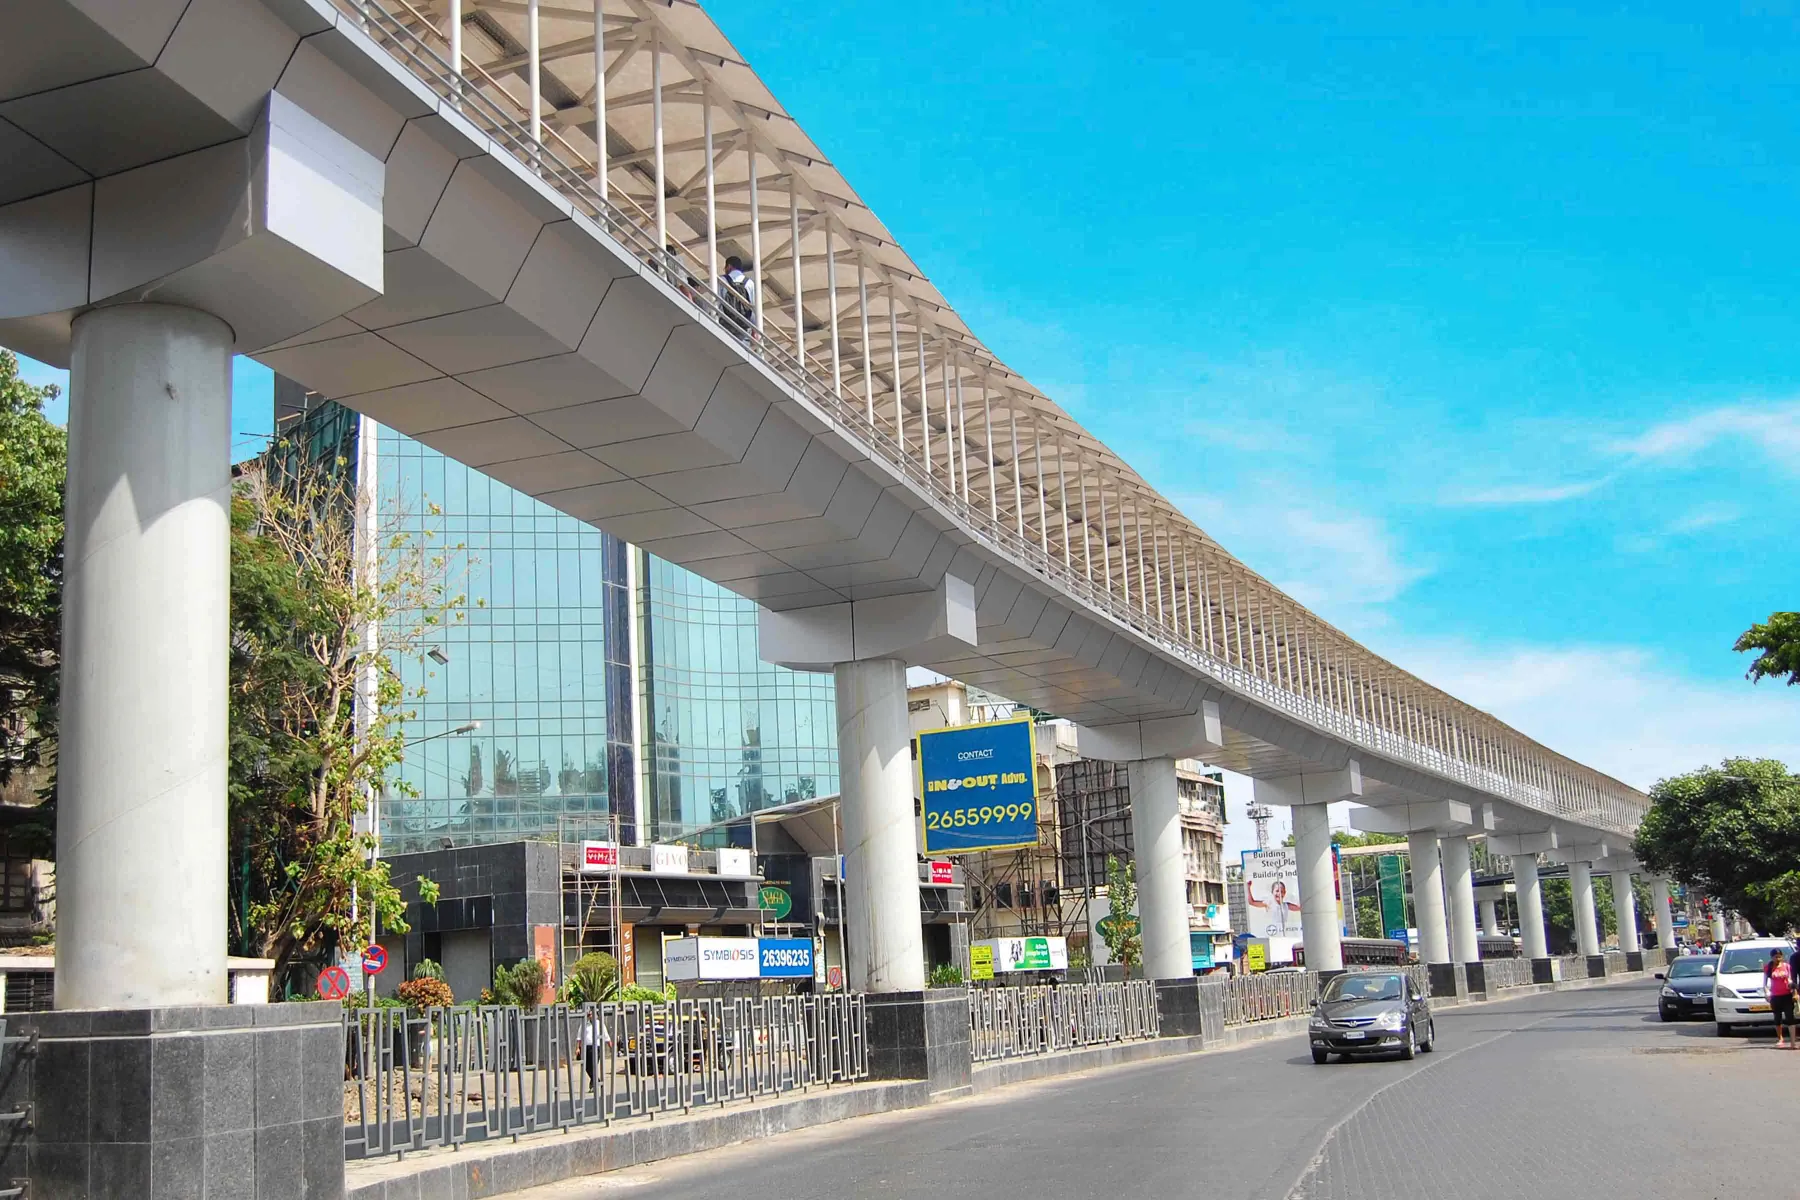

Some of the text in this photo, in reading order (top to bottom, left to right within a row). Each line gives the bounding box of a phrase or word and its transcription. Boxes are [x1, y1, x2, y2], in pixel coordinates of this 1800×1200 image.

[957, 748, 994, 762] CONTACT
[927, 802, 1033, 830] 26559999
[656, 853, 686, 866] GIVO
[1253, 851, 1286, 860] Building
[1261, 859, 1281, 868] Steel
[1252, 871, 1284, 879] Building
[704, 949, 755, 961] SYMBIOSIS
[762, 949, 810, 967] 26396235
